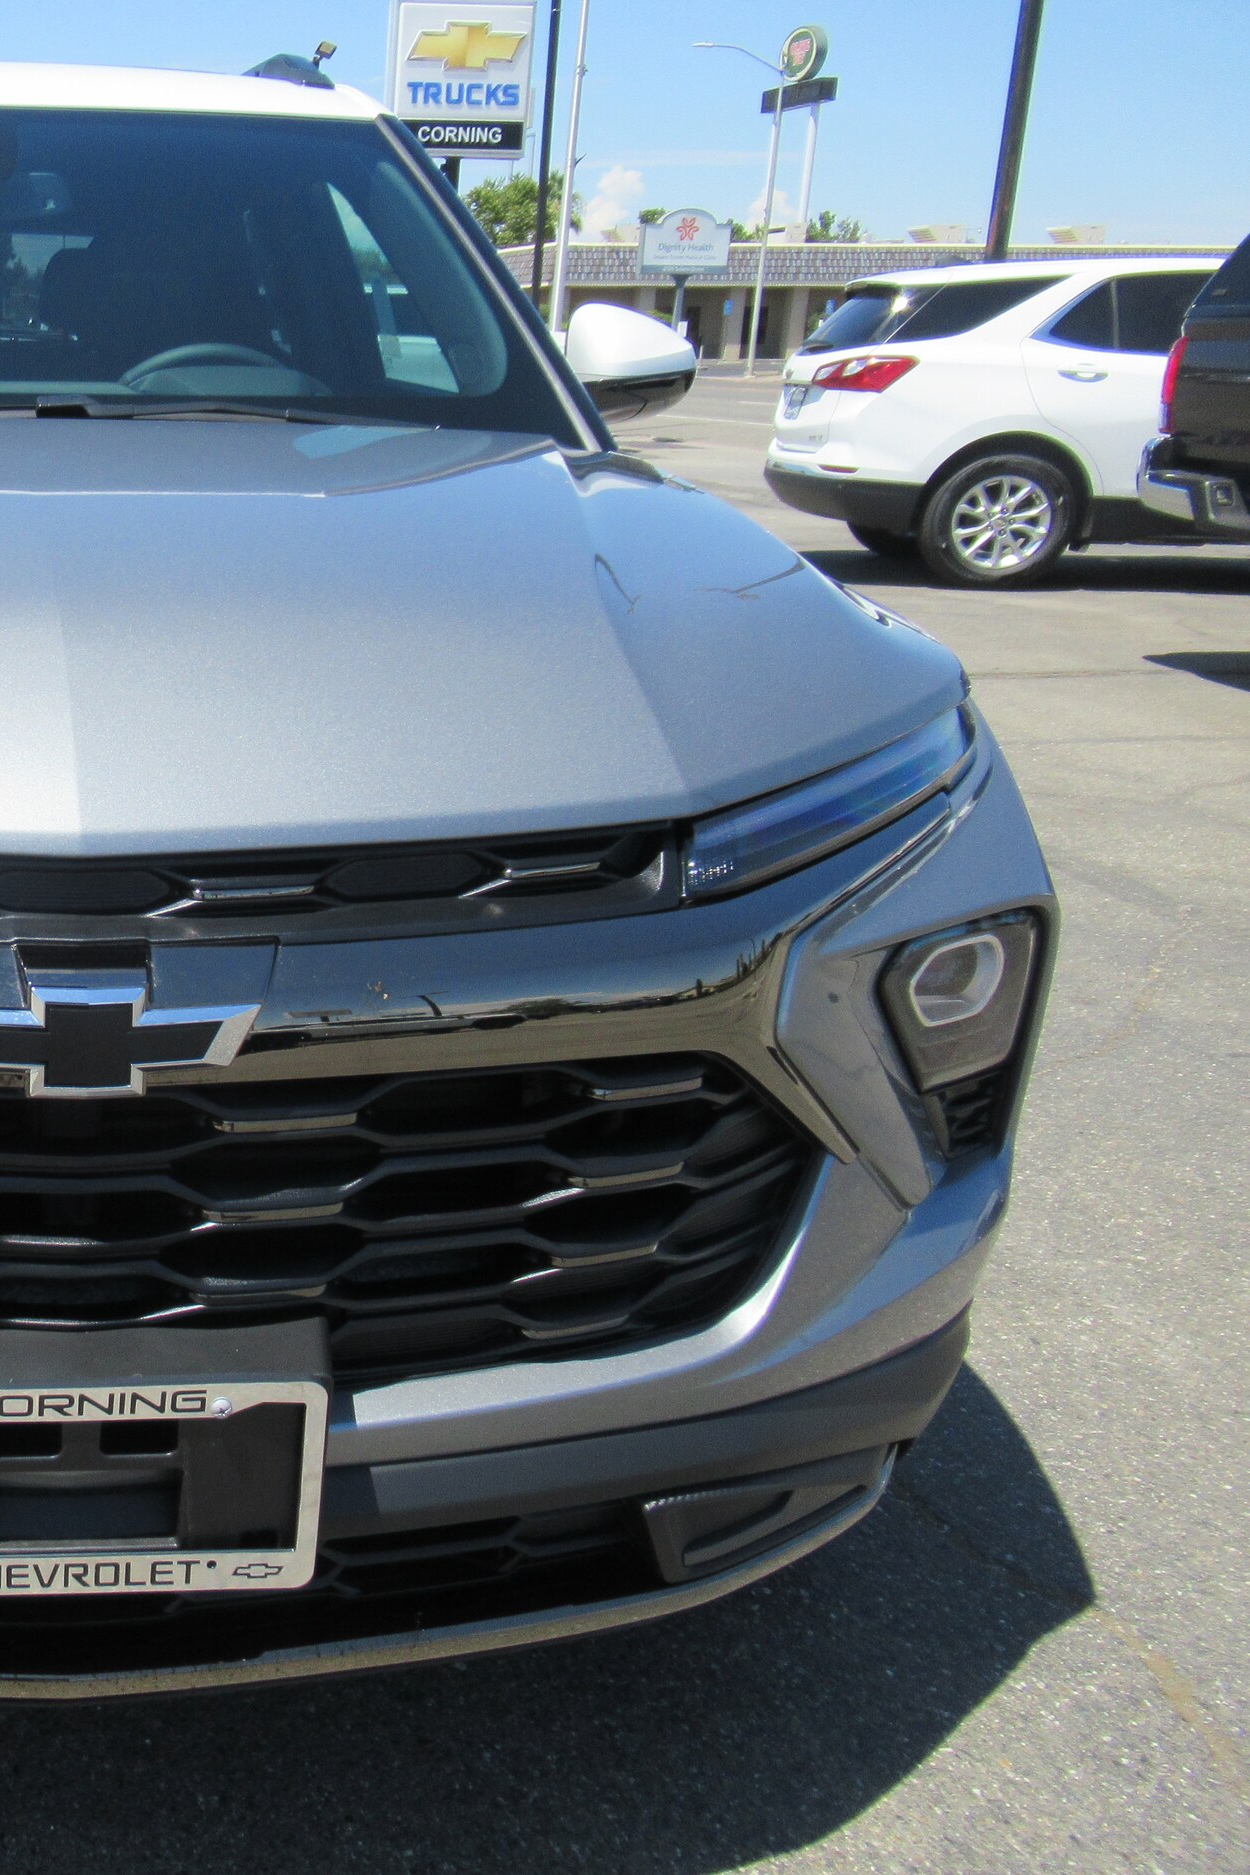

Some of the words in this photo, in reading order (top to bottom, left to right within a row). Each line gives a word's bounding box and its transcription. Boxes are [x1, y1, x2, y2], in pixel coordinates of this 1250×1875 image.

[407, 81, 520, 106] TRUCKS
[417, 125, 502, 143] CORNING
[658, 243, 685, 253] Dignity
[687, 243, 714, 252] Health
